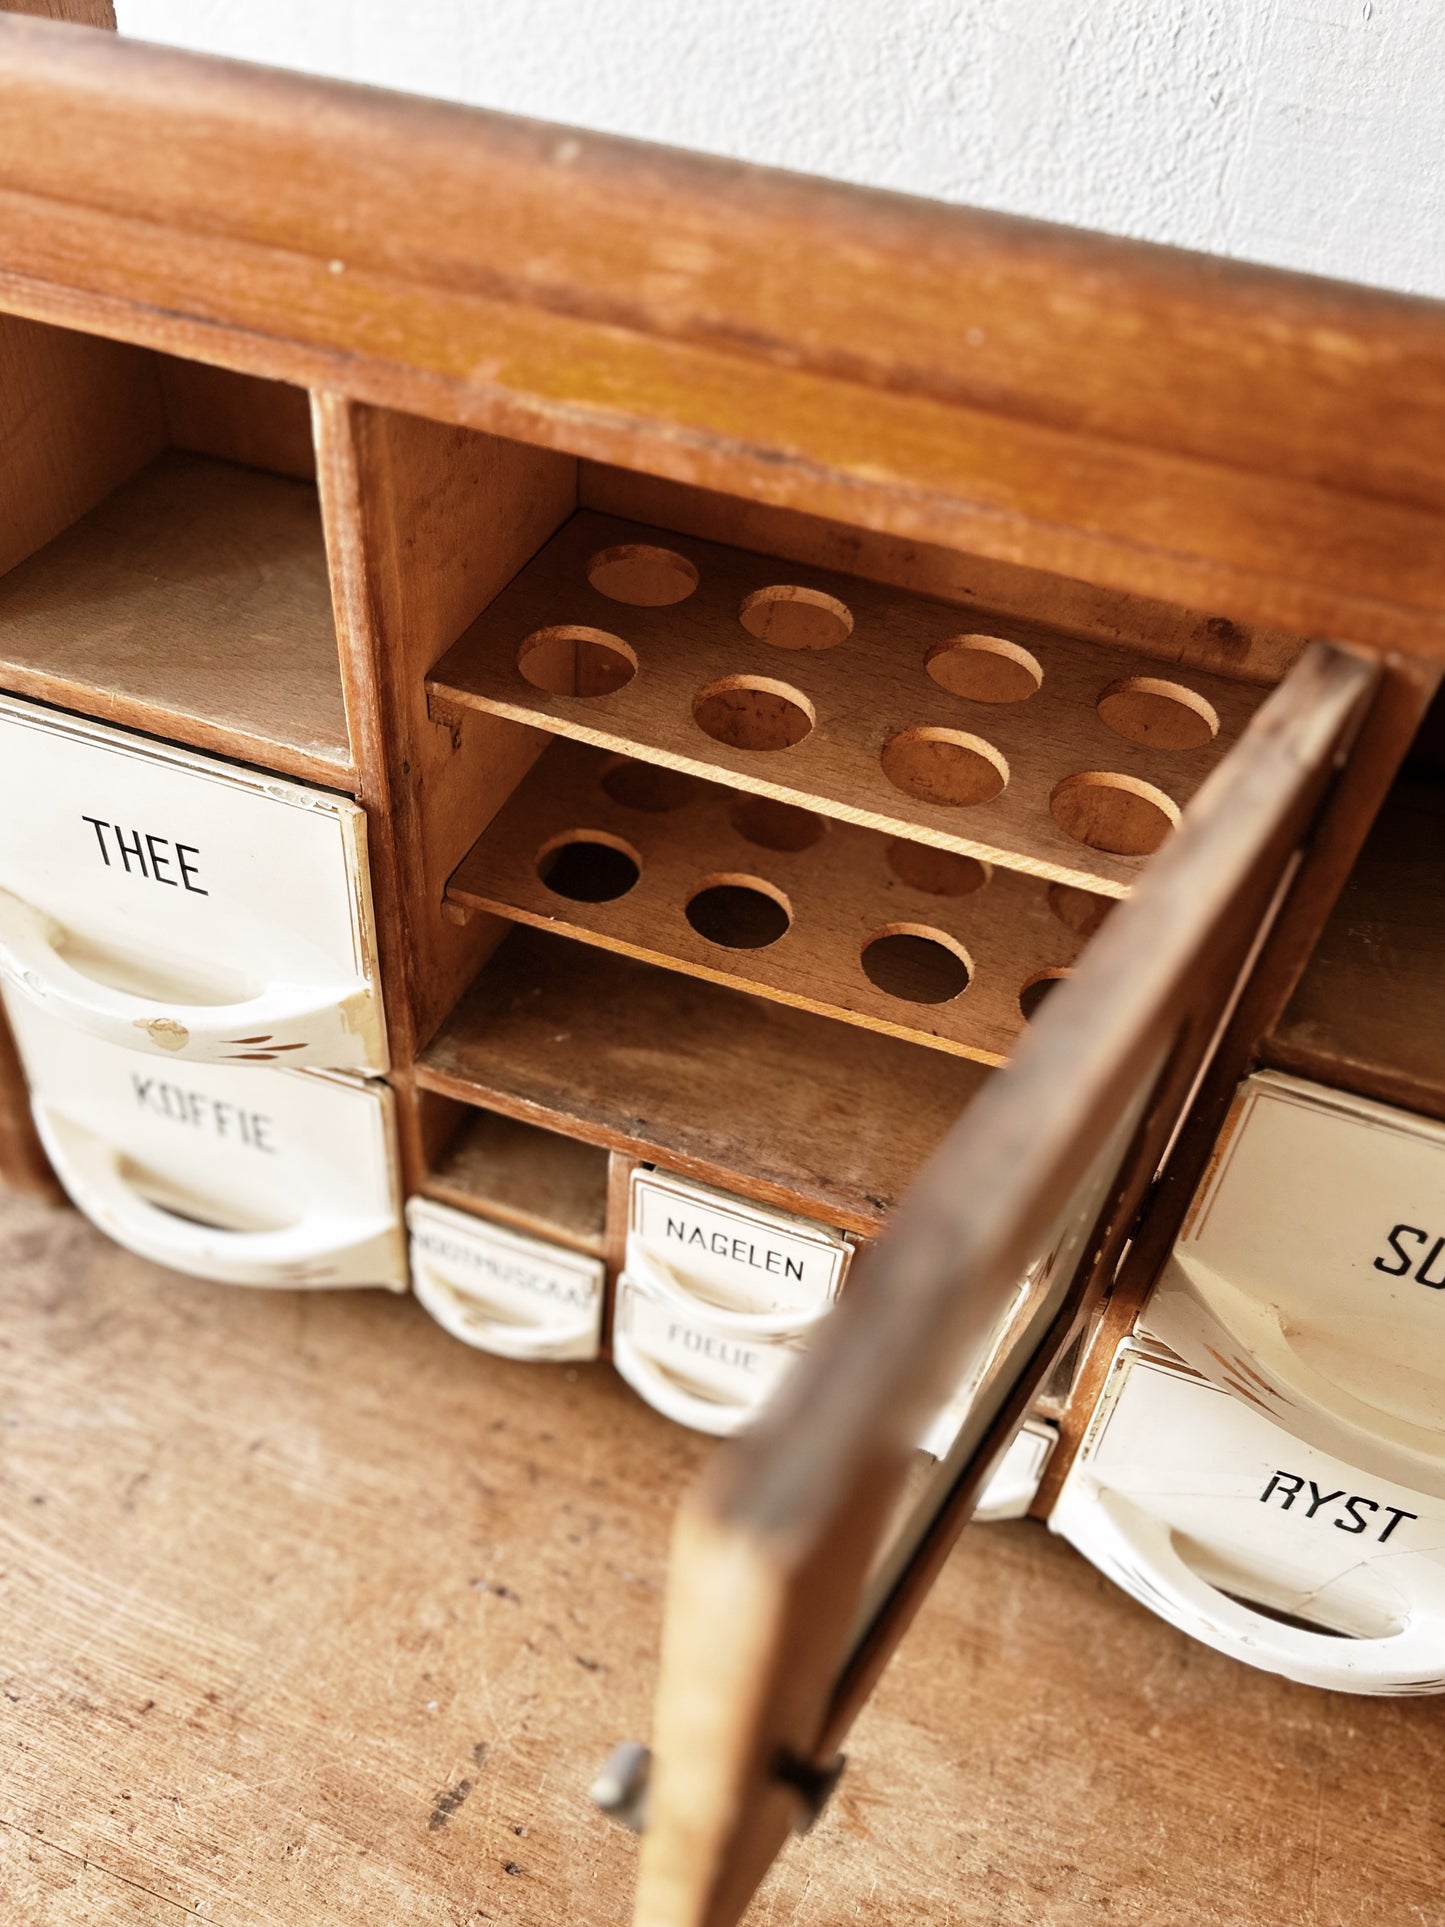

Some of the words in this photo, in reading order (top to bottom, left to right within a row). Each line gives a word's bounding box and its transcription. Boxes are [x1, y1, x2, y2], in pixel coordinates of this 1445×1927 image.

[82, 815, 209, 896] THEE
[131, 1071, 275, 1154] KOFFIE
[667, 1217, 804, 1281] NAGELEN
[669, 1322, 760, 1371] FOELIE
[1259, 1470, 1418, 1543] RYST
